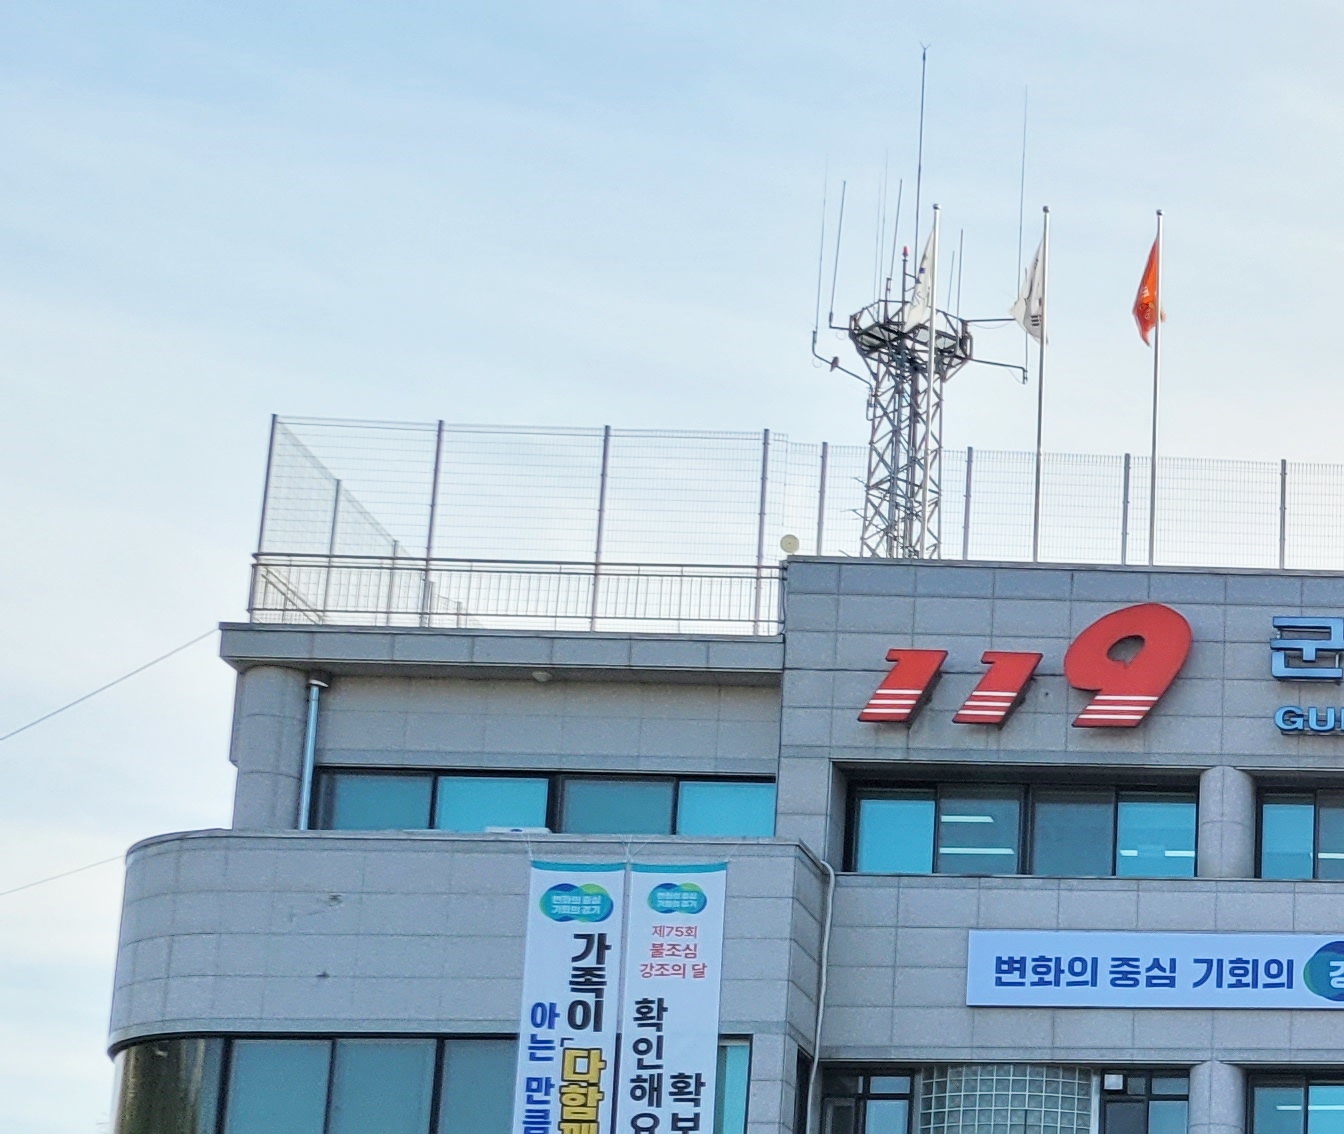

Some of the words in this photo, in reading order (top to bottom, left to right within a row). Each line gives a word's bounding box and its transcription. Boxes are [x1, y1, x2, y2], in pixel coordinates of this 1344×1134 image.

[859, 602, 1193, 728] 119
[652, 925, 698, 938] 제75회
[650, 943, 698, 959] 불조심
[567, 933, 611, 1032] 가족이
[640, 963, 687, 979] 강조의
[691, 963, 708, 979] 달
[993, 955, 1099, 989] 변화의
[1108, 956, 1177, 990] 중심
[1192, 958, 1294, 990] 기회의
[527, 1002, 560, 1062] 아는
